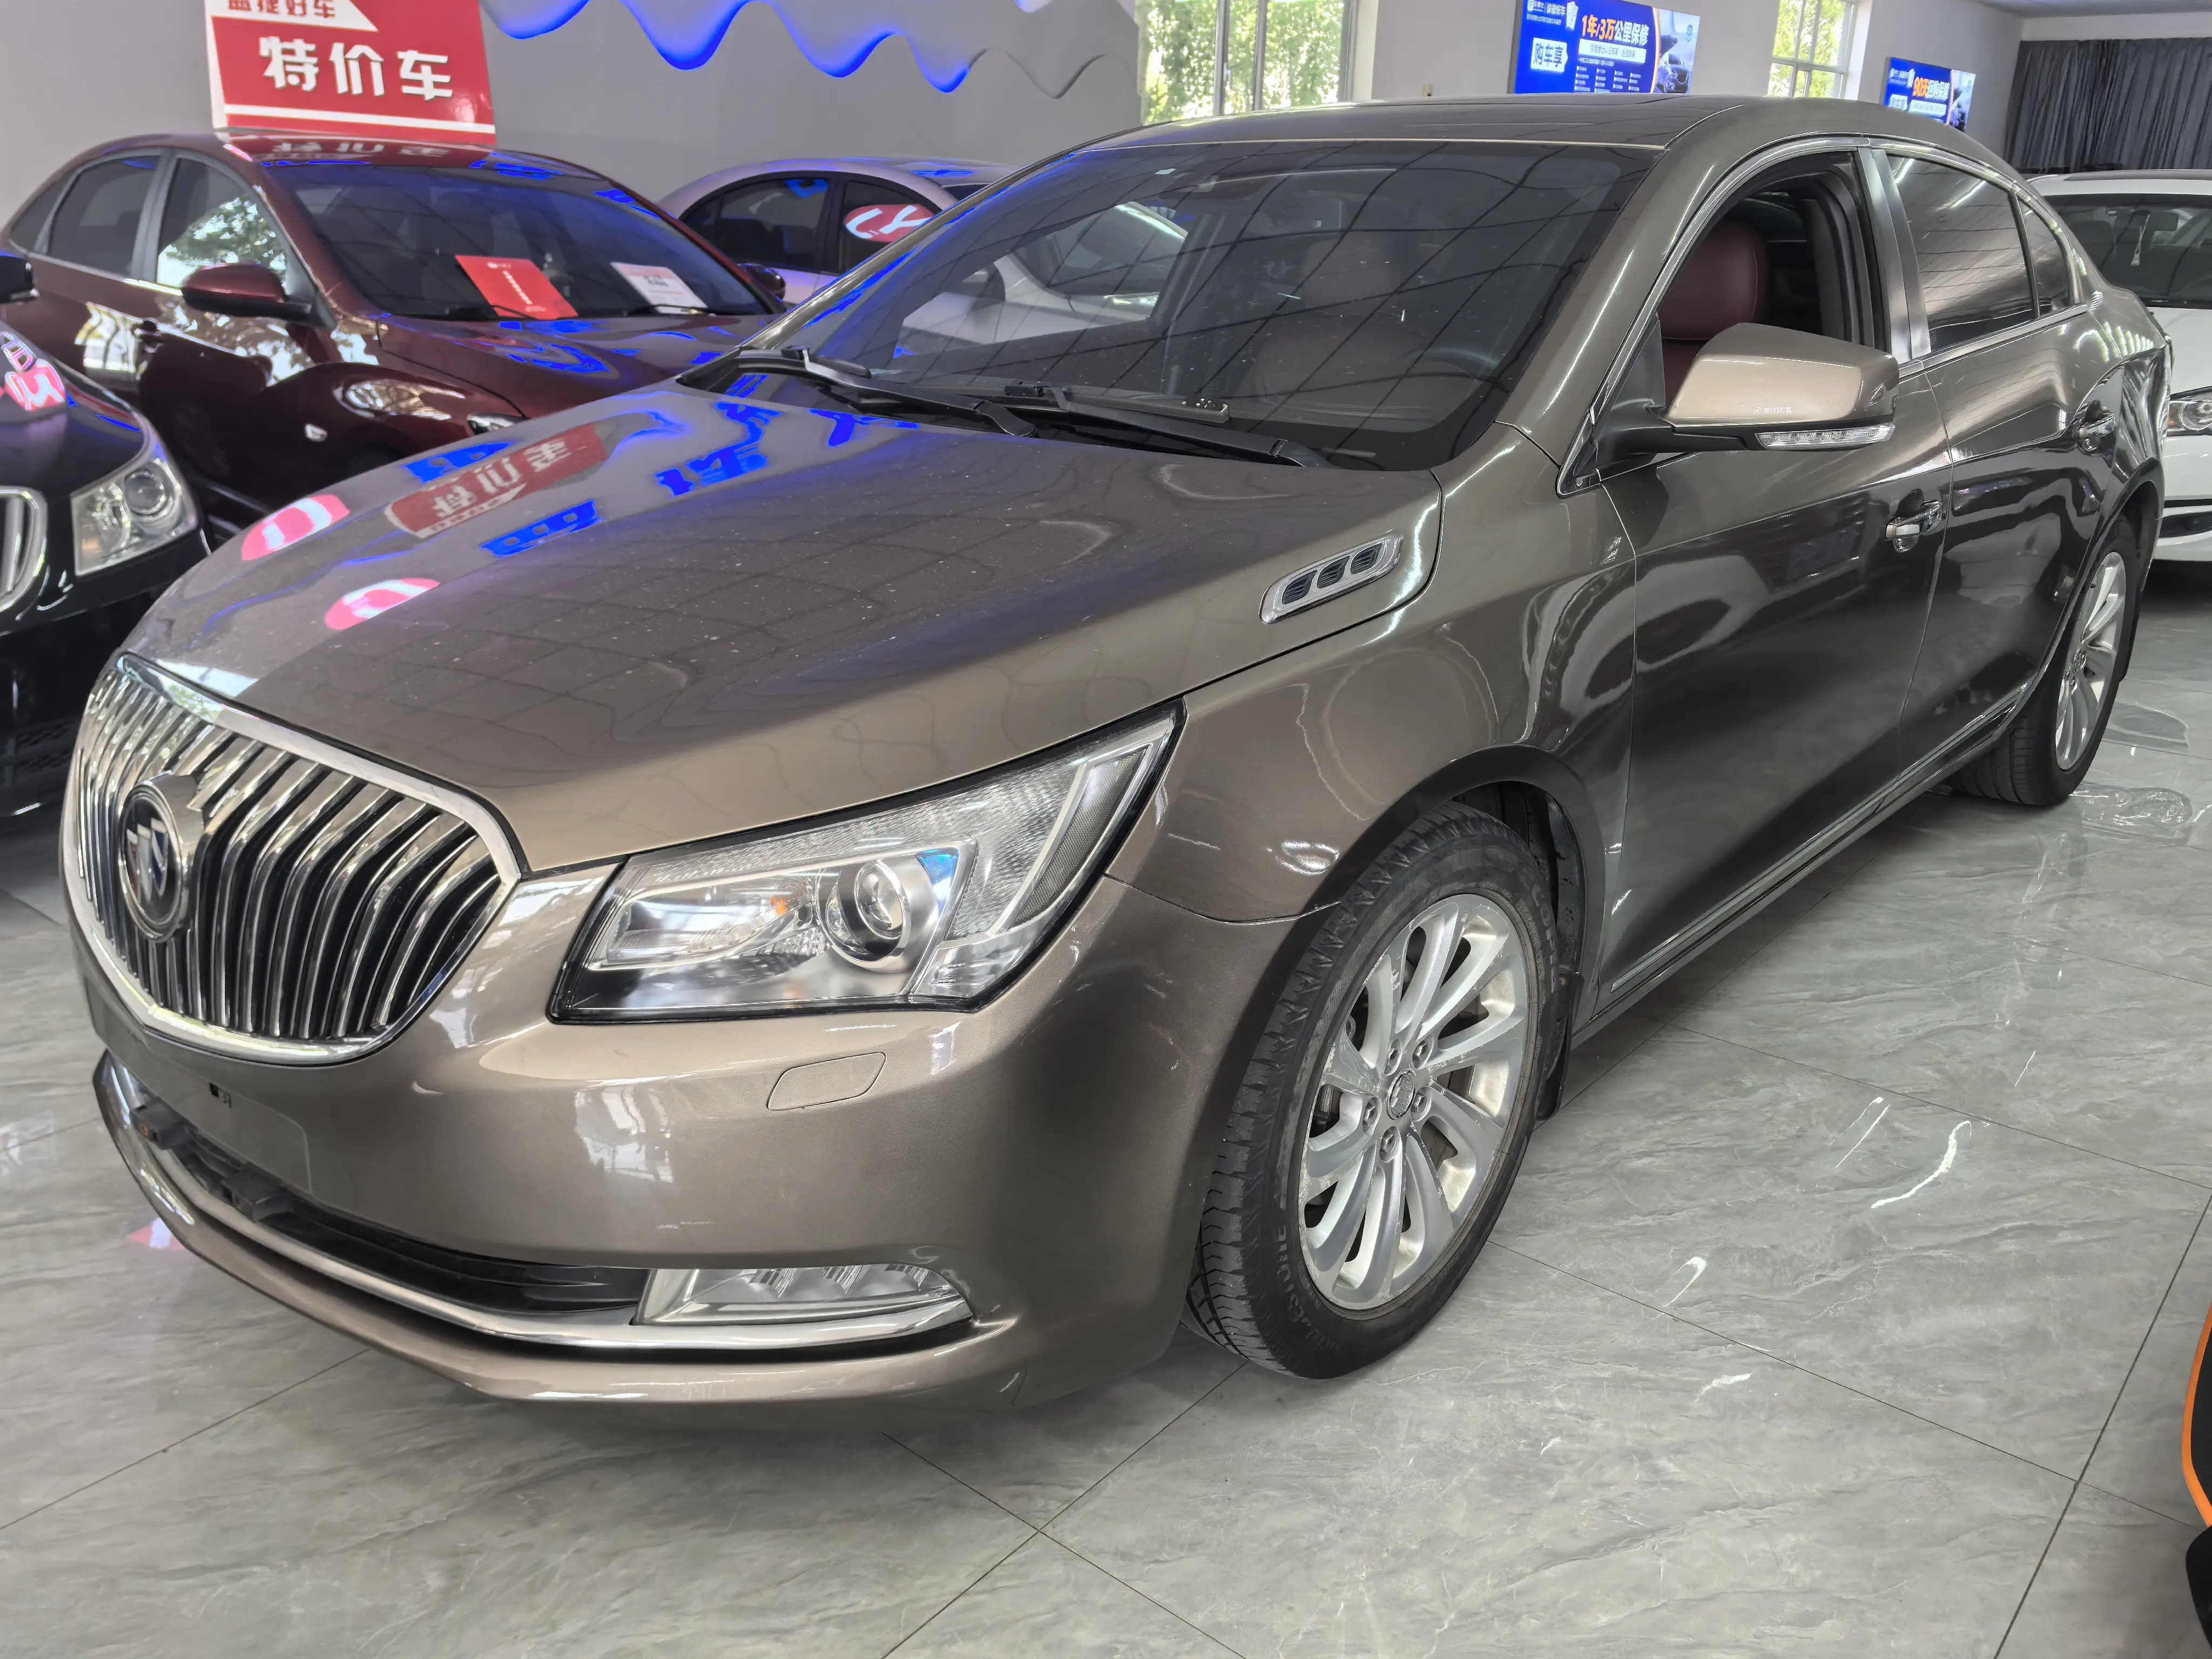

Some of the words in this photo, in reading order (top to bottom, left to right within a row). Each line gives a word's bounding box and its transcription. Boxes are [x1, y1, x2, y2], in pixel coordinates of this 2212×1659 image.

[1582, 14, 1649, 46] 1年/3万公里保修
[259, 36, 453, 100] 特价车
[1533, 43, 1563, 68] 购车享
